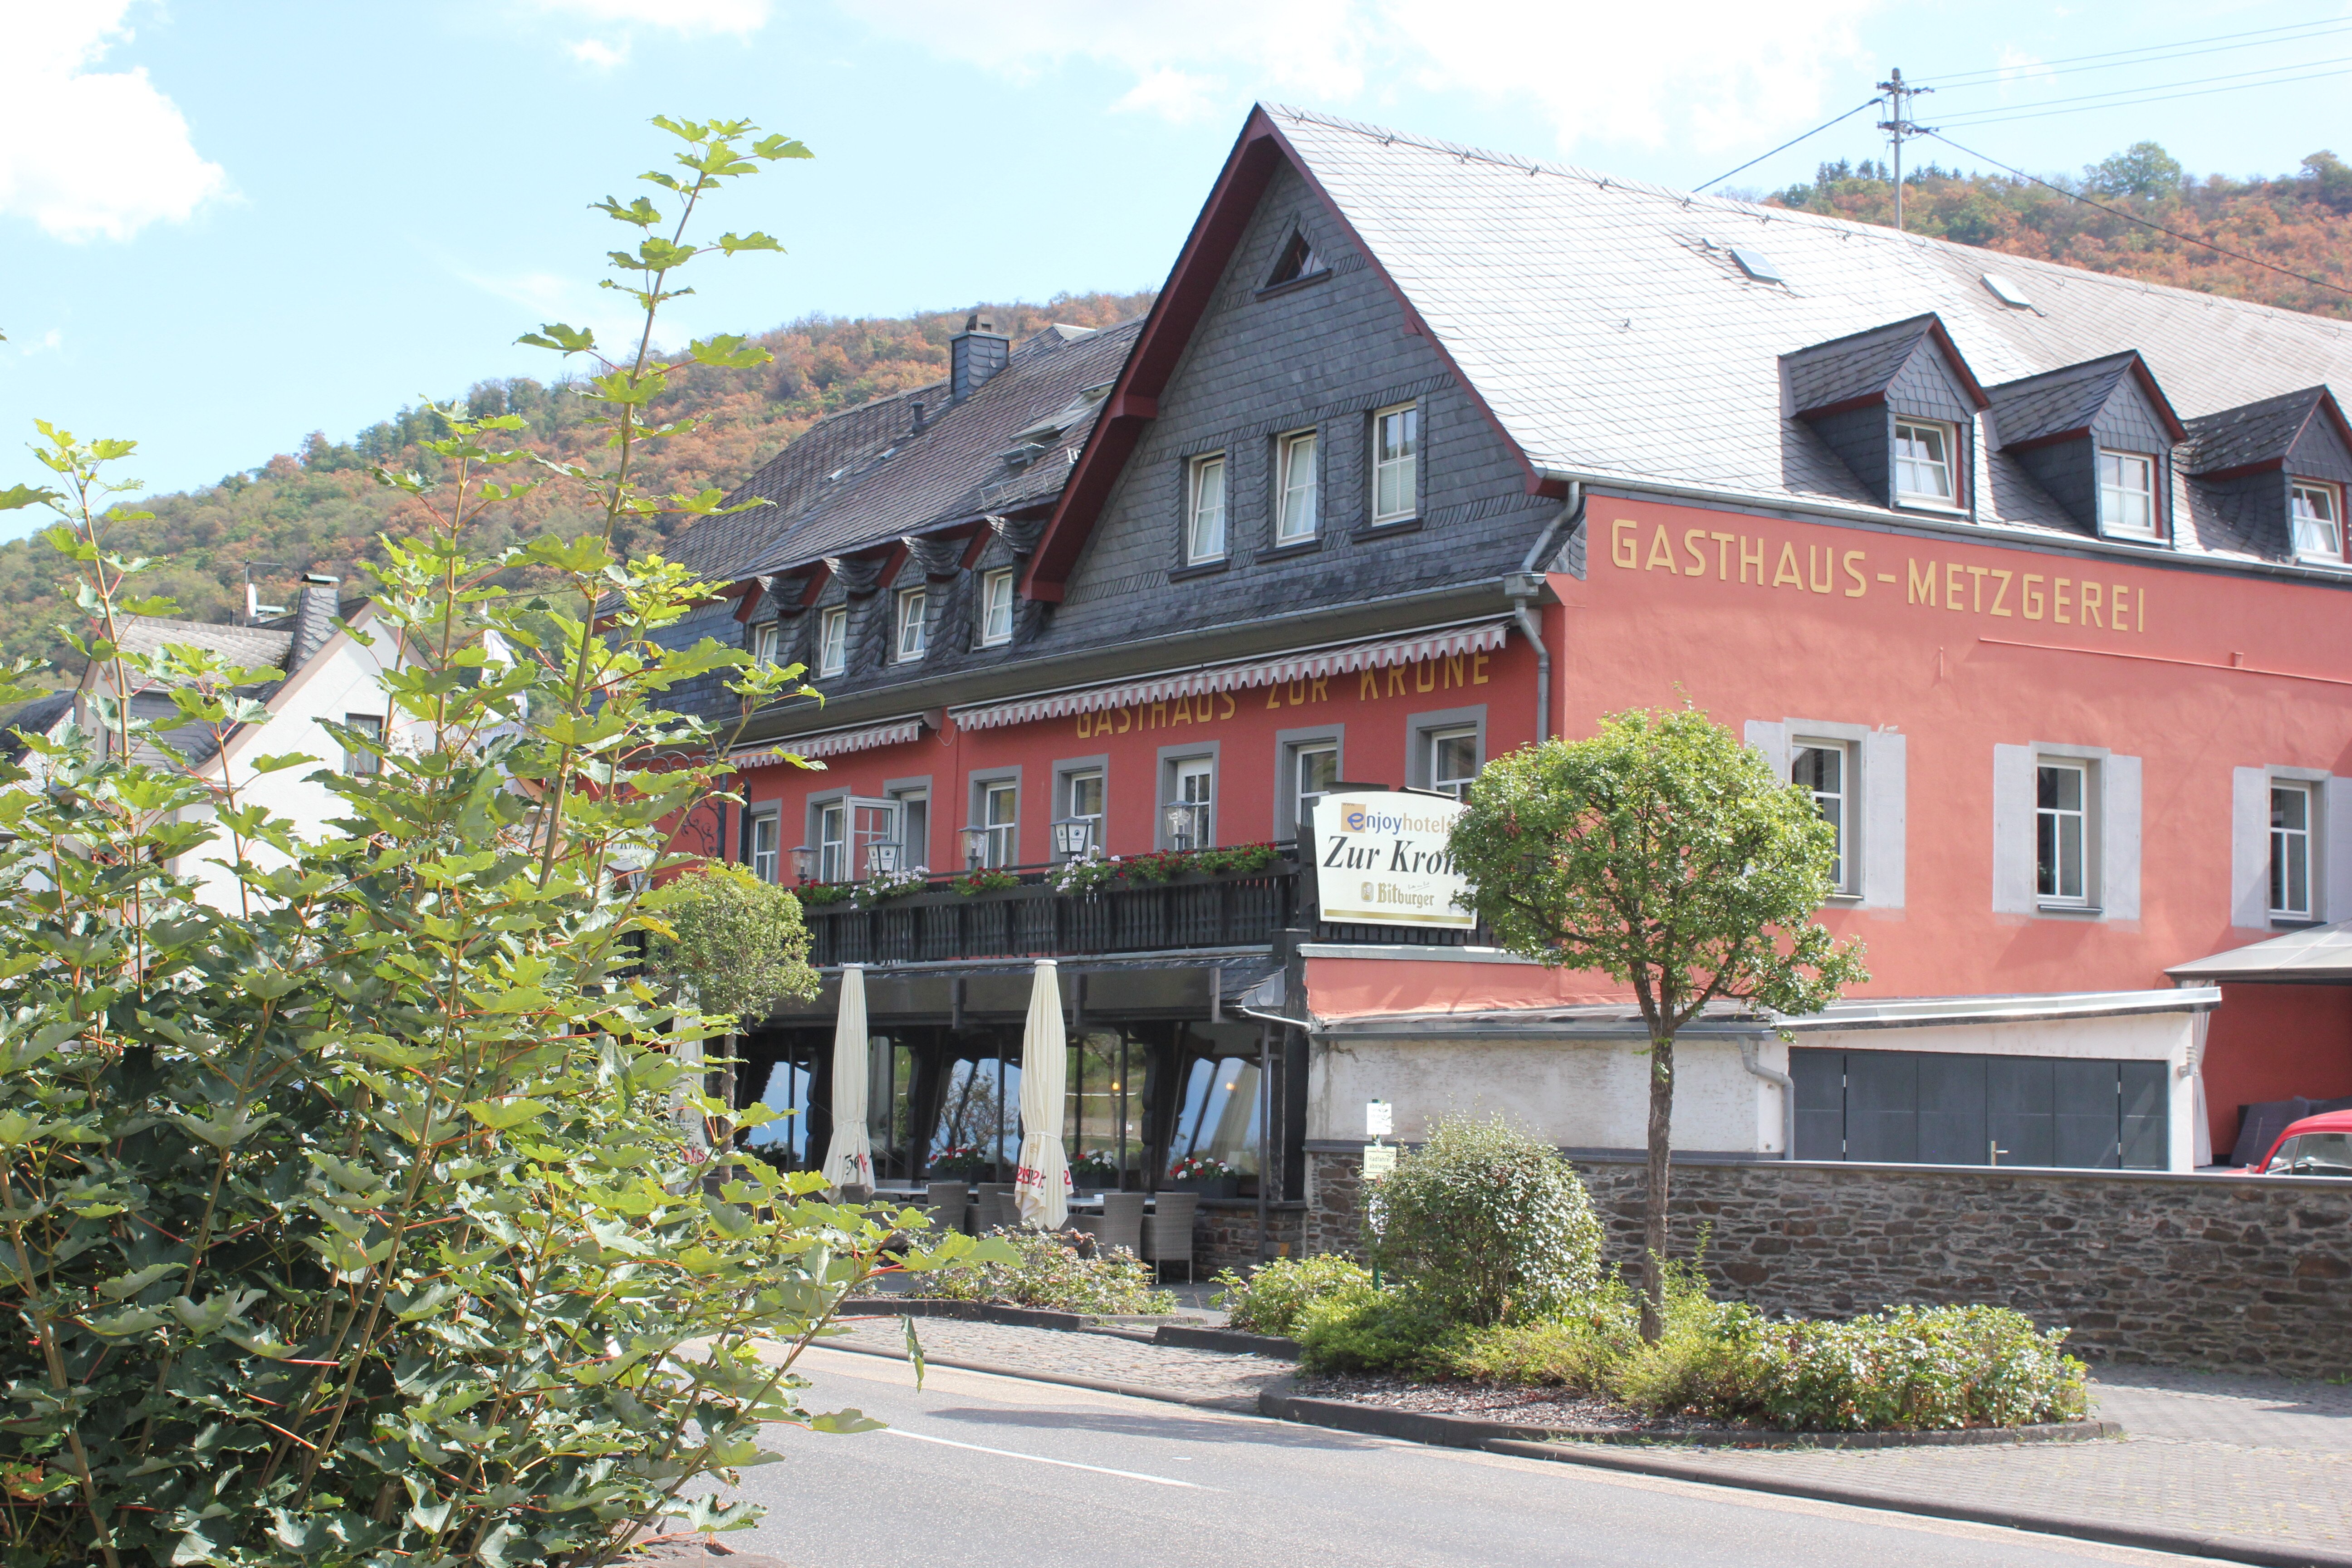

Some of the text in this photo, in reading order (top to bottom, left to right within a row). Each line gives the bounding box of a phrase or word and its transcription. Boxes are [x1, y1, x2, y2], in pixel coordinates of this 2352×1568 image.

[1323, 836, 1469, 877] Zur Kron
[1377, 882, 1435, 909] Bitburger
